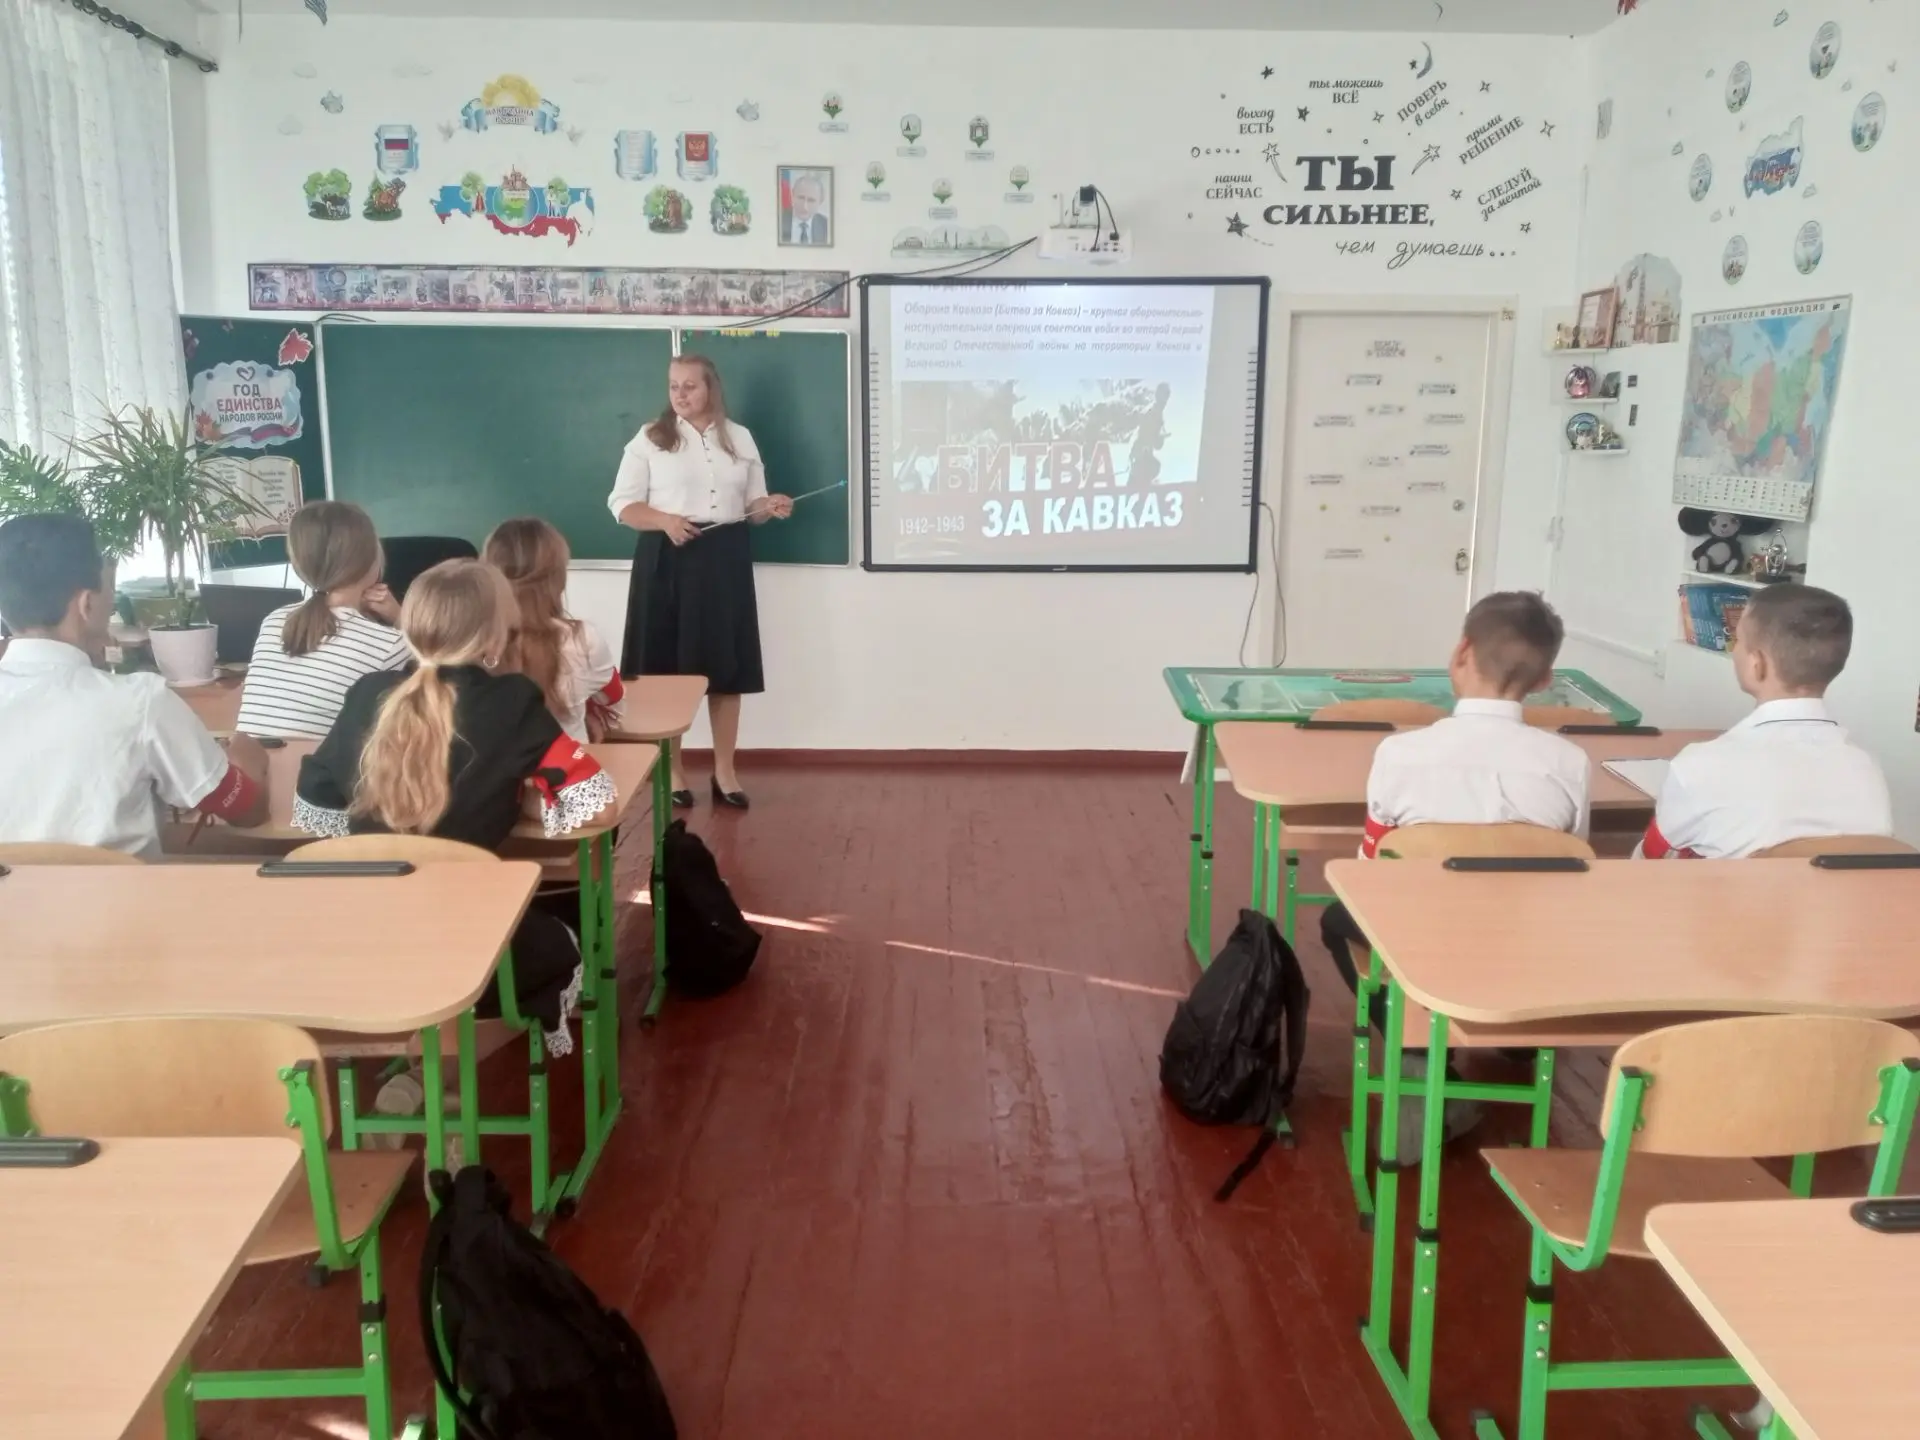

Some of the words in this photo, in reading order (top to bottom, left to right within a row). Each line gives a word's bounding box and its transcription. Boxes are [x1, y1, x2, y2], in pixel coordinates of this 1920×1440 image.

[1308, 79, 1331, 89] ты
[1331, 78, 1385, 89] можешь
[1331, 89, 1360, 104] ВСЁ
[1396, 80, 1448, 122] ПОВЕРЬ
[1236, 106, 1275, 123] выход
[1413, 113, 1424, 127] в
[1423, 97, 1450, 120] себя
[1238, 122, 1275, 135] ЕСТЬ
[1465, 113, 1504, 145] прими
[1458, 115, 1525, 165] РЕШЕНИЕ
[1214, 173, 1253, 184] начни
[1295, 155, 1397, 192] ТЫ
[1205, 184, 1263, 200] СЕЙЧАС
[1476, 167, 1533, 206] СЛЕДУЙ
[1480, 202, 1497, 222] за
[1496, 176, 1543, 210] мечтой
[1262, 203, 1435, 227] СИЛЬНЕЕ,
[1335, 240, 1376, 256] чем
[232, 383, 261, 398] ГОД
[216, 397, 283, 414] ЕДИНСТВА
[219, 411, 256, 424] НАРОДОВ
[936, 441, 1120, 493] БИТВА
[981, 499, 1031, 538] ЗА
[1042, 490, 1184, 535] КАВКАЗ
